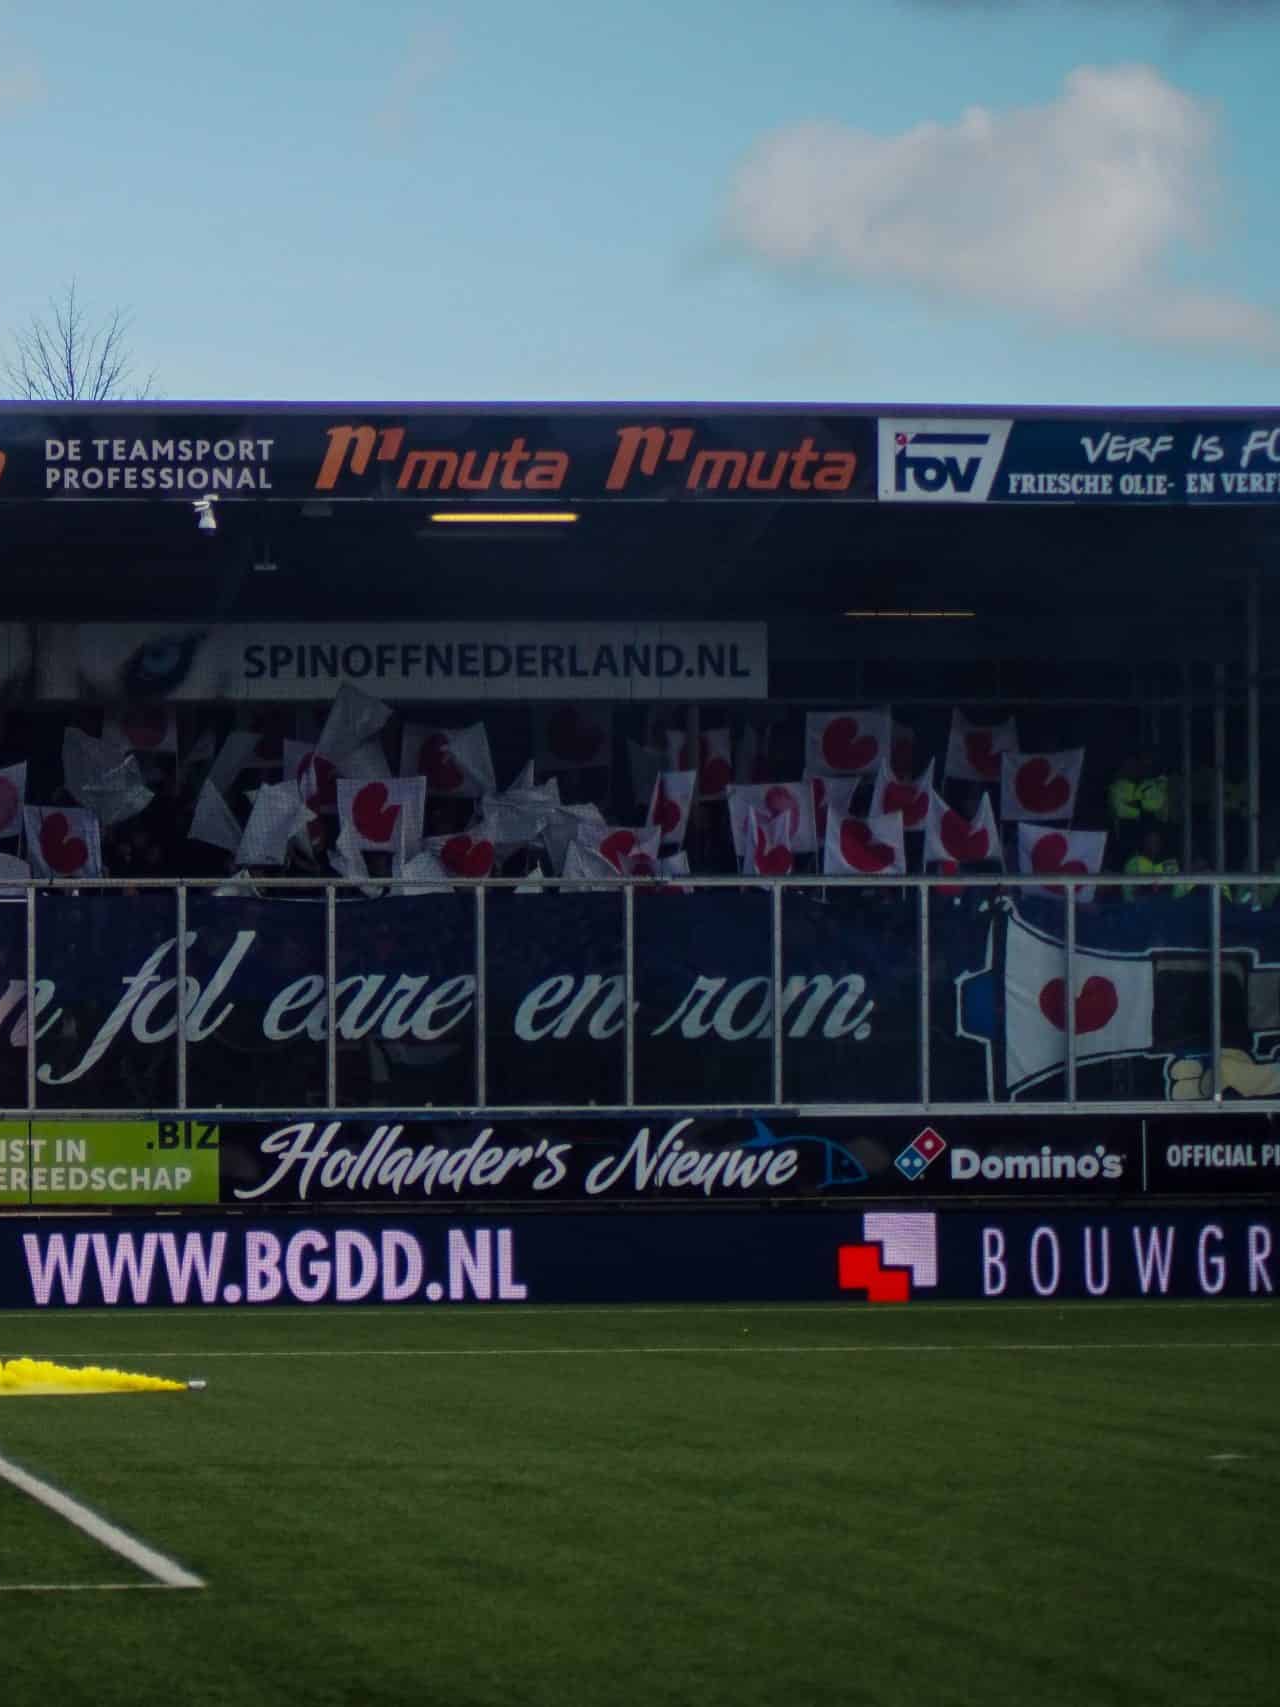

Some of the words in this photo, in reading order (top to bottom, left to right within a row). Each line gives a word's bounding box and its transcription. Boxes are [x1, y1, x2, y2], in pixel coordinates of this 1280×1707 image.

[45, 439, 82, 461] DE
[93, 439, 274, 461] TEAMSPORT
[396, 437, 569, 490] muta
[686, 437, 857, 490] muta
[1080, 432, 1174, 463] VERF
[1191, 433, 1224, 462] IS
[45, 467, 272, 489] PROFESSIONAL
[1008, 472, 1113, 495] FRIESCHE
[1119, 473, 1175, 495] OLIE-
[1185, 472, 1216, 494] EN
[1220, 472, 1280, 494] VERF
[243, 643, 751, 678] SPINOFFNEDERLAND.NL
[36, 929, 256, 1084] fol
[262, 973, 476, 1042] eare
[514, 973, 639, 1042] en
[55, 1139, 86, 1163] IN
[233, 1121, 572, 1199] Hollander's
[585, 1118, 798, 1196] Nieuwe
[951, 1145, 1123, 1180] Domino's
[1167, 1143, 1257, 1168] OFFICIAL
[23, 1230, 527, 1304] WWW.BGDD.NL
[983, 1225, 1272, 1295] BOUWGR
